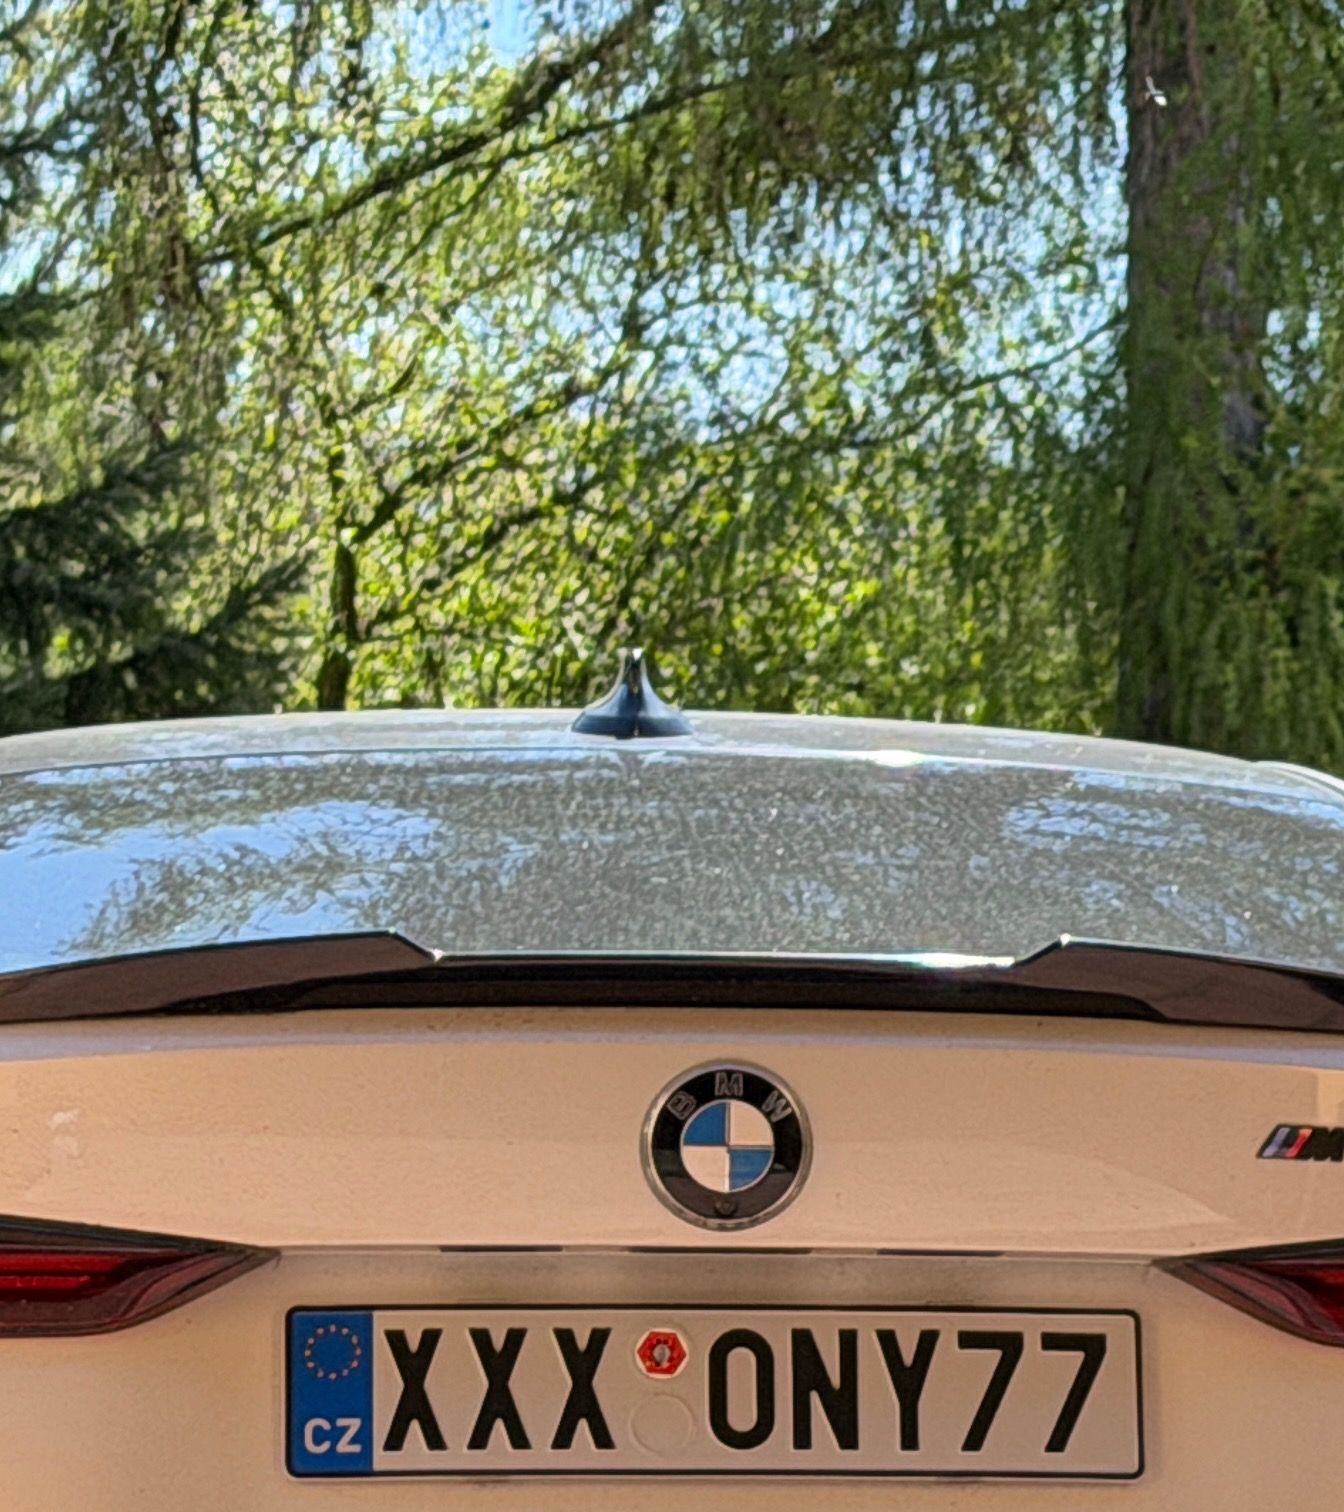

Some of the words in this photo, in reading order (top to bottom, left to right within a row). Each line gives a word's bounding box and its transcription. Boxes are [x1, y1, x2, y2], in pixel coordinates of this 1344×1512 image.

[666, 1072, 793, 1123] BMW
[382, 1327, 617, 1452] XXX
[303, 1417, 362, 1455] CZ
